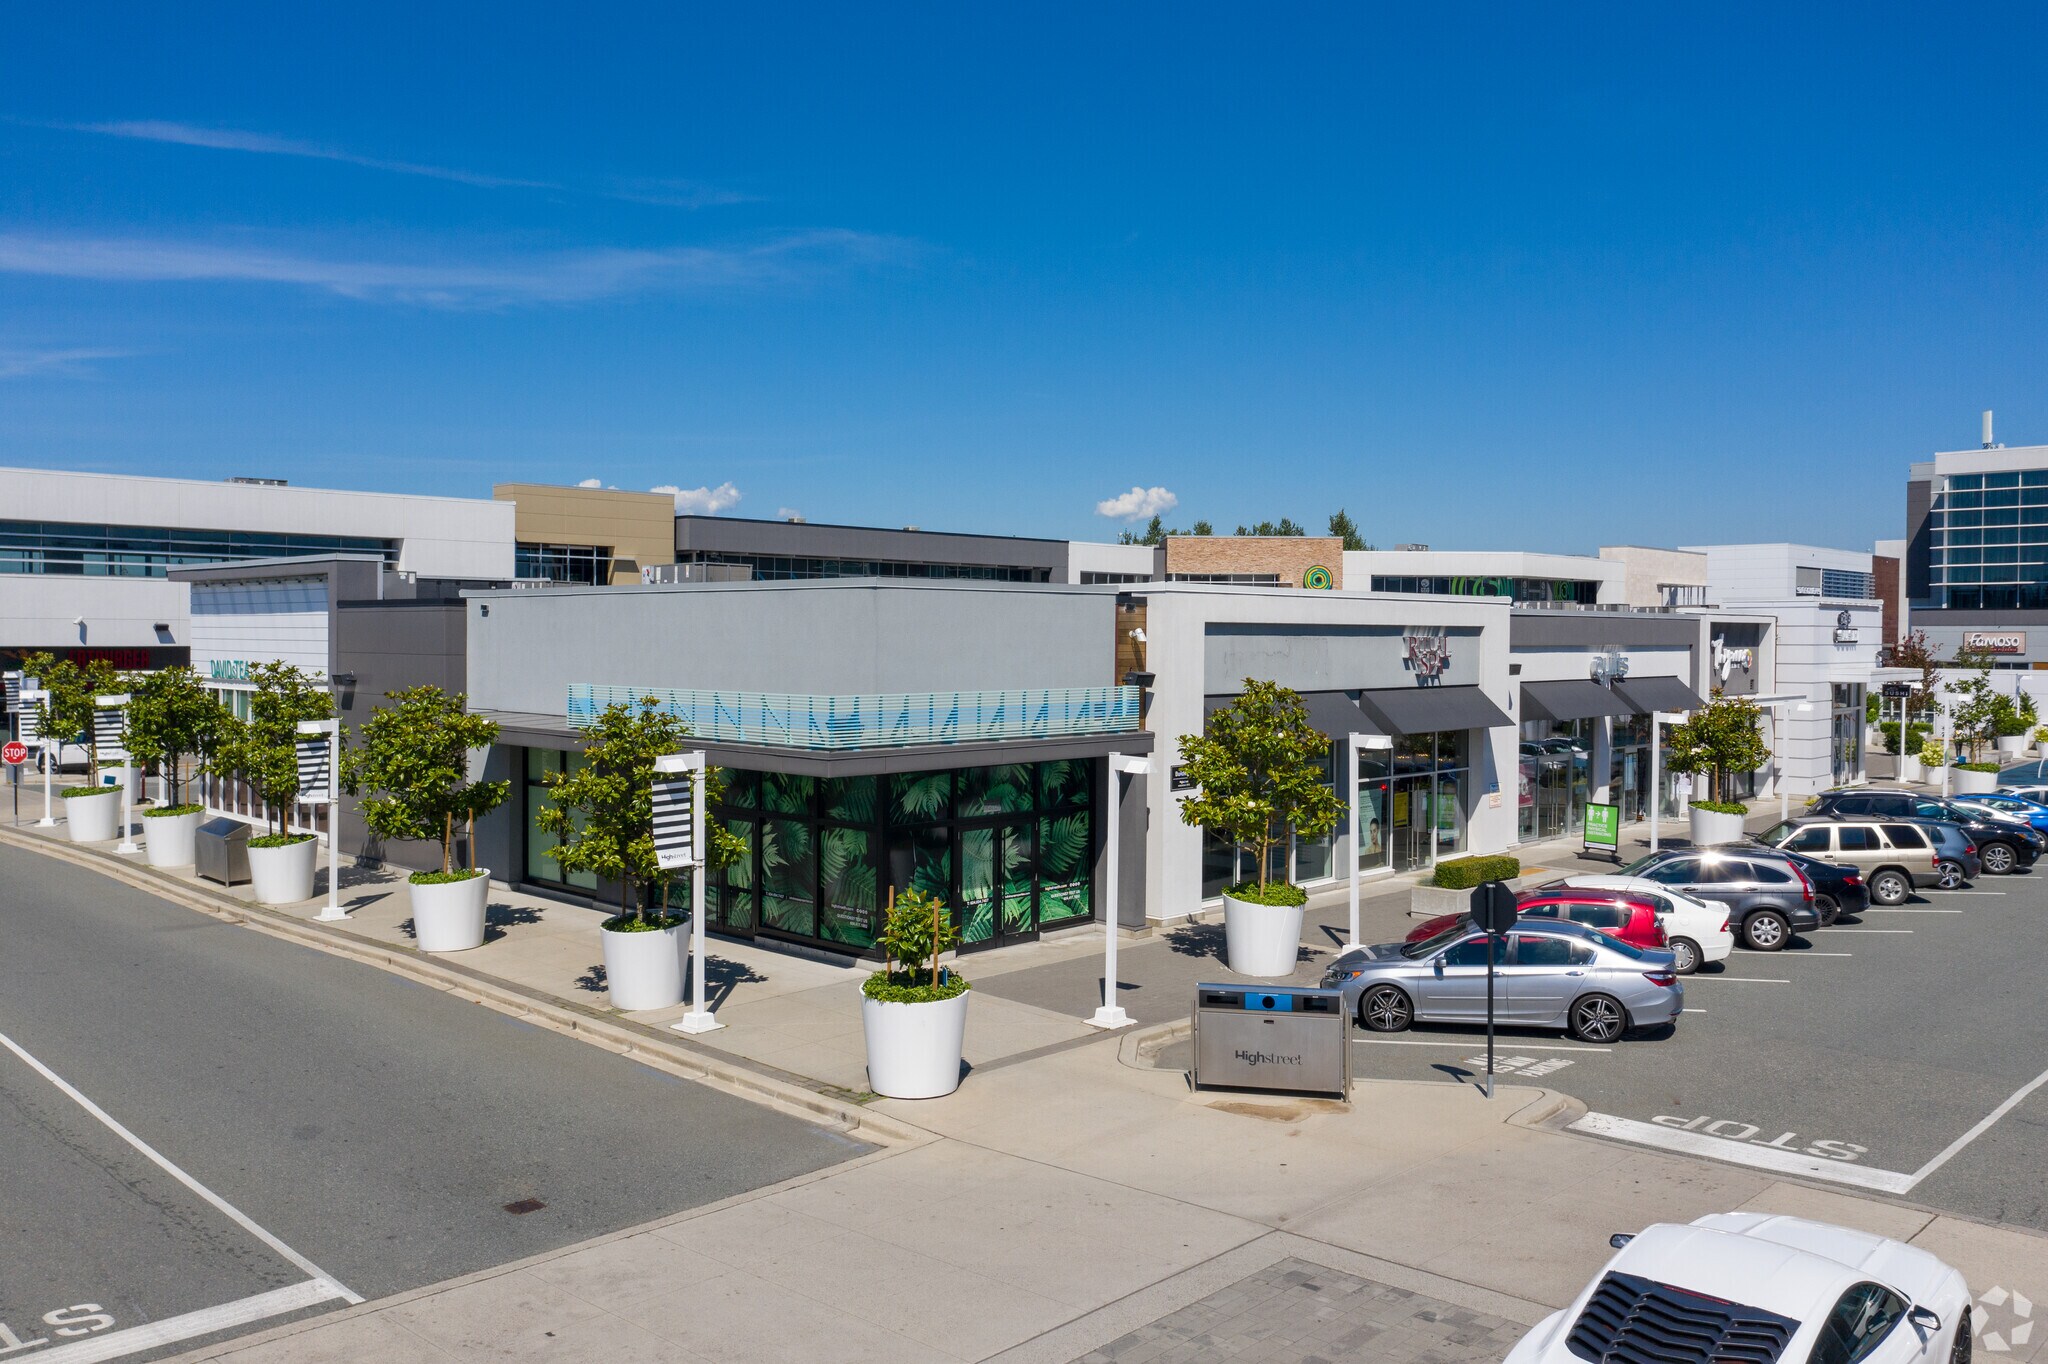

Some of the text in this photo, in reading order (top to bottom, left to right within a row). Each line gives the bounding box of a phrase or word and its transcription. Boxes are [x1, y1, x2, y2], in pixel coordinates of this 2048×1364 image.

[1969, 633, 2020, 647] Famoso
[4, 747, 26, 756] STOP
[1235, 1050, 1304, 1066] Highstreet
[1652, 1115, 1869, 1161] STOP
